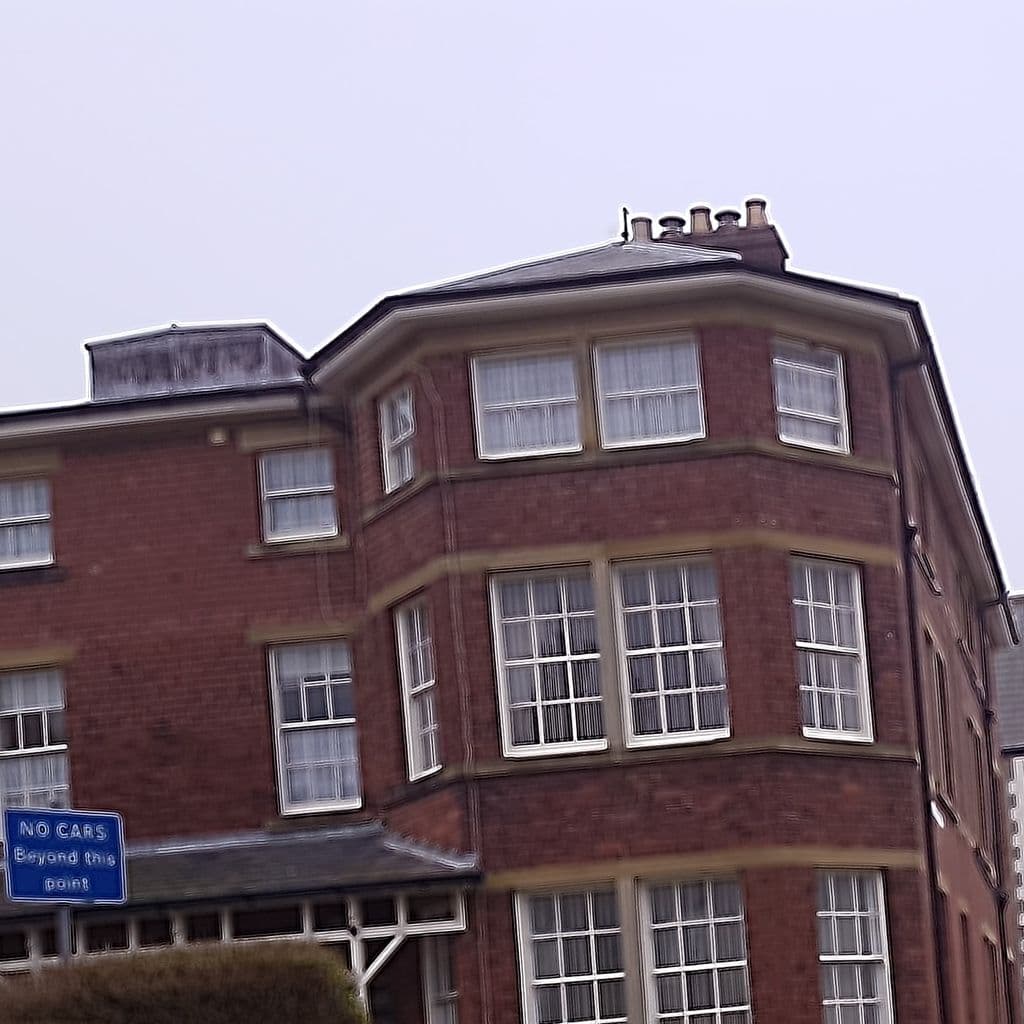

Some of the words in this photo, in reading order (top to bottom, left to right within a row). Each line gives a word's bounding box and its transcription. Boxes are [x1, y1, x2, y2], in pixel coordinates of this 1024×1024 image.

[20, 820, 49, 838] NO
[56, 822, 107, 841] CARS
[14, 847, 78, 866] Beyond
[84, 851, 116, 867] this
[45, 877, 89, 892] point
